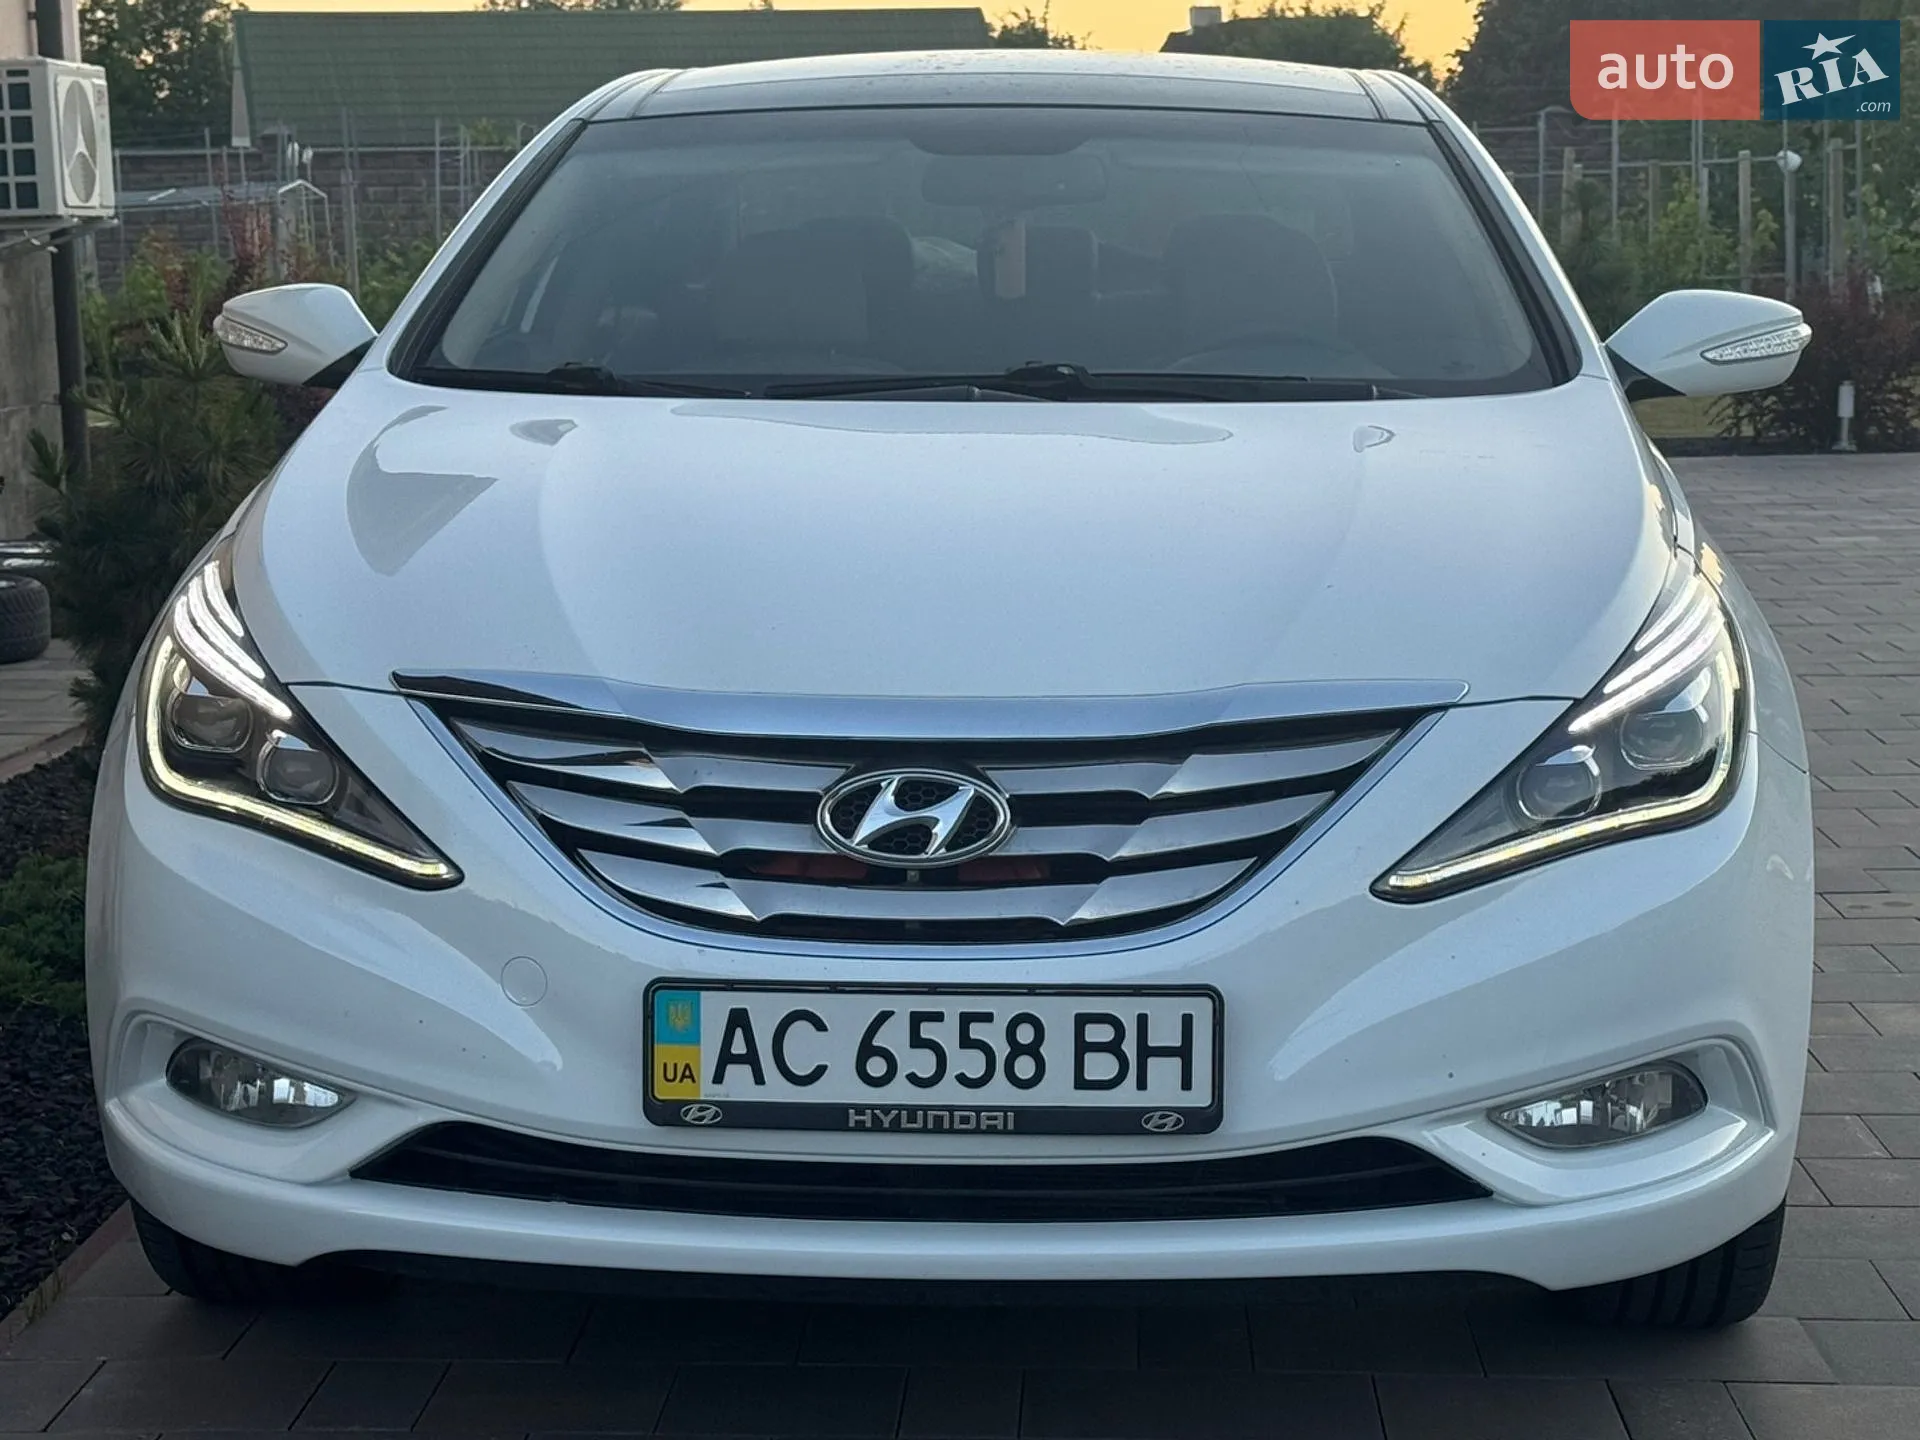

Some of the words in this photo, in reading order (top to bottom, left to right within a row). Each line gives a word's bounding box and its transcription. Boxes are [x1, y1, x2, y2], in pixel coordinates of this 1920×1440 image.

[712, 1007, 829, 1088] AC
[854, 1010, 1047, 1090] 6558
[1073, 1012, 1194, 1092] BH
[662, 1062, 697, 1085] UA
[848, 1108, 1015, 1131] HYUNDAI
